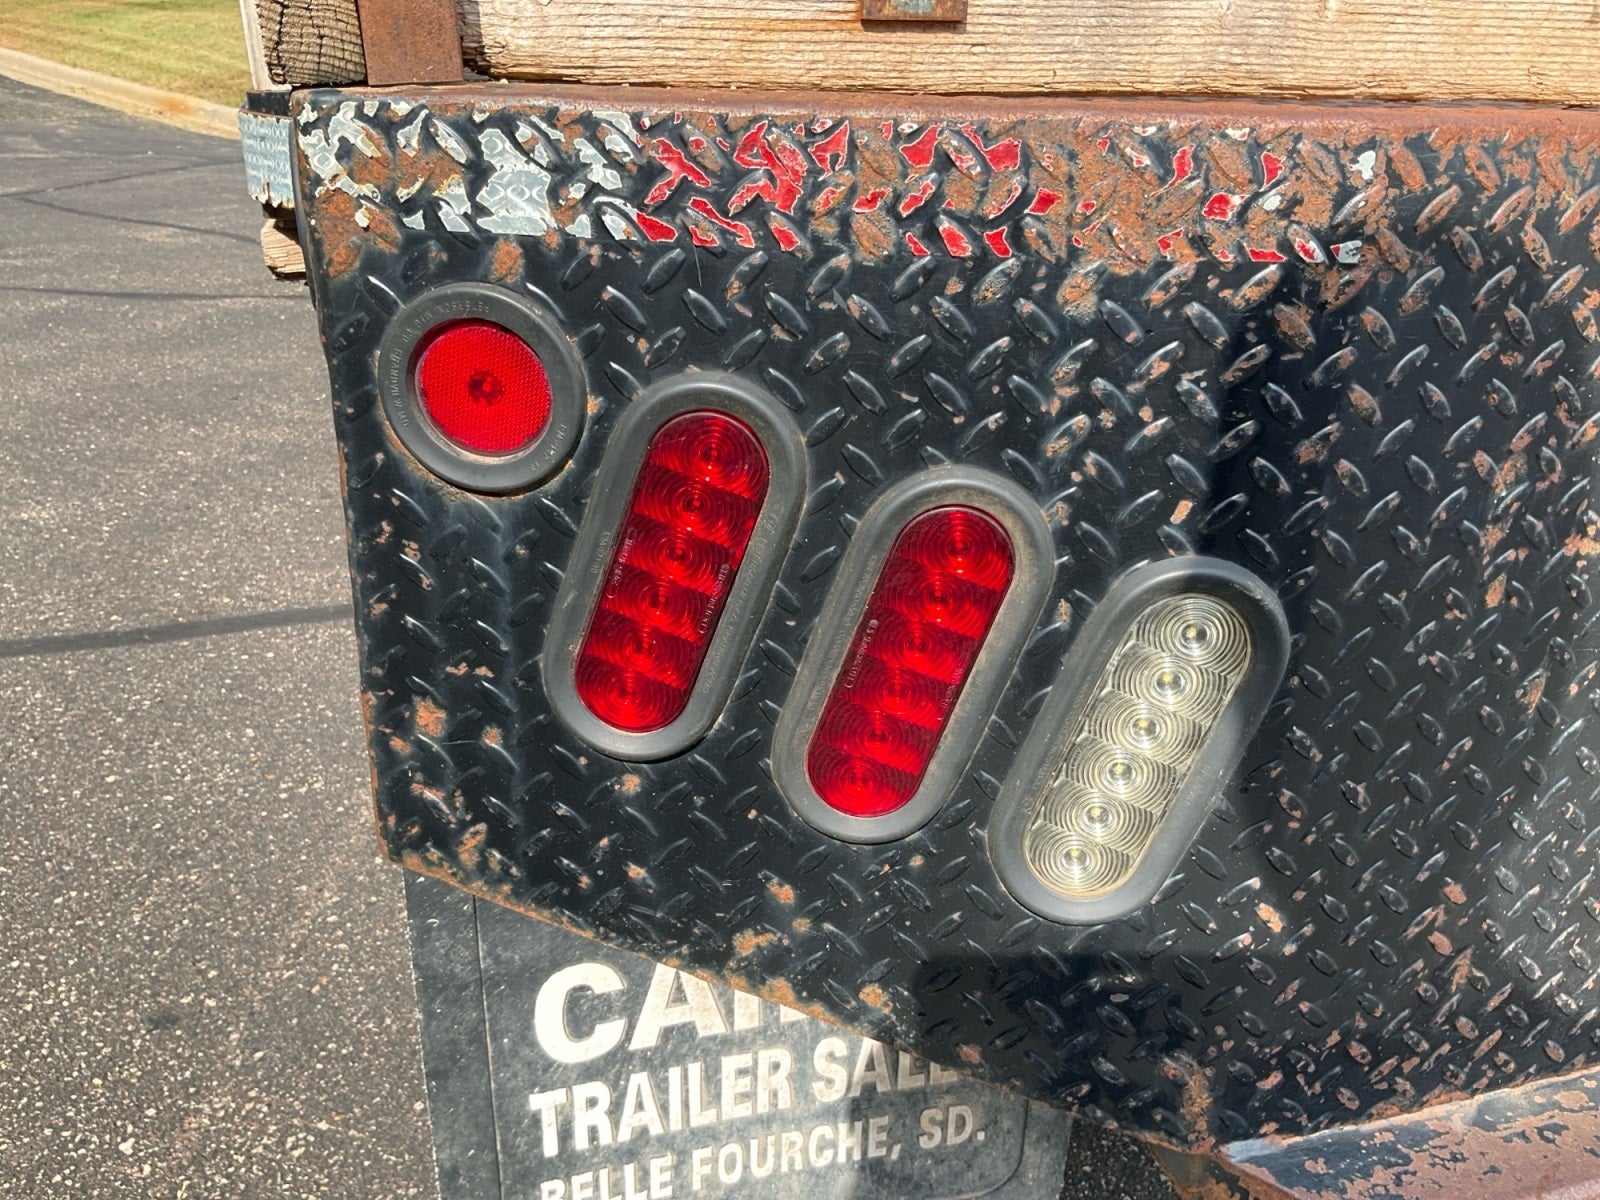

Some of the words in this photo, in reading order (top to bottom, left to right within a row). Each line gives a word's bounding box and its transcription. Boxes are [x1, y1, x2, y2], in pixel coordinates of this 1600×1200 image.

[529, 1047, 792, 1159] TRAILER
[692, 1115, 902, 1191] FOURCHE,
[918, 1104, 986, 1149] SD.
